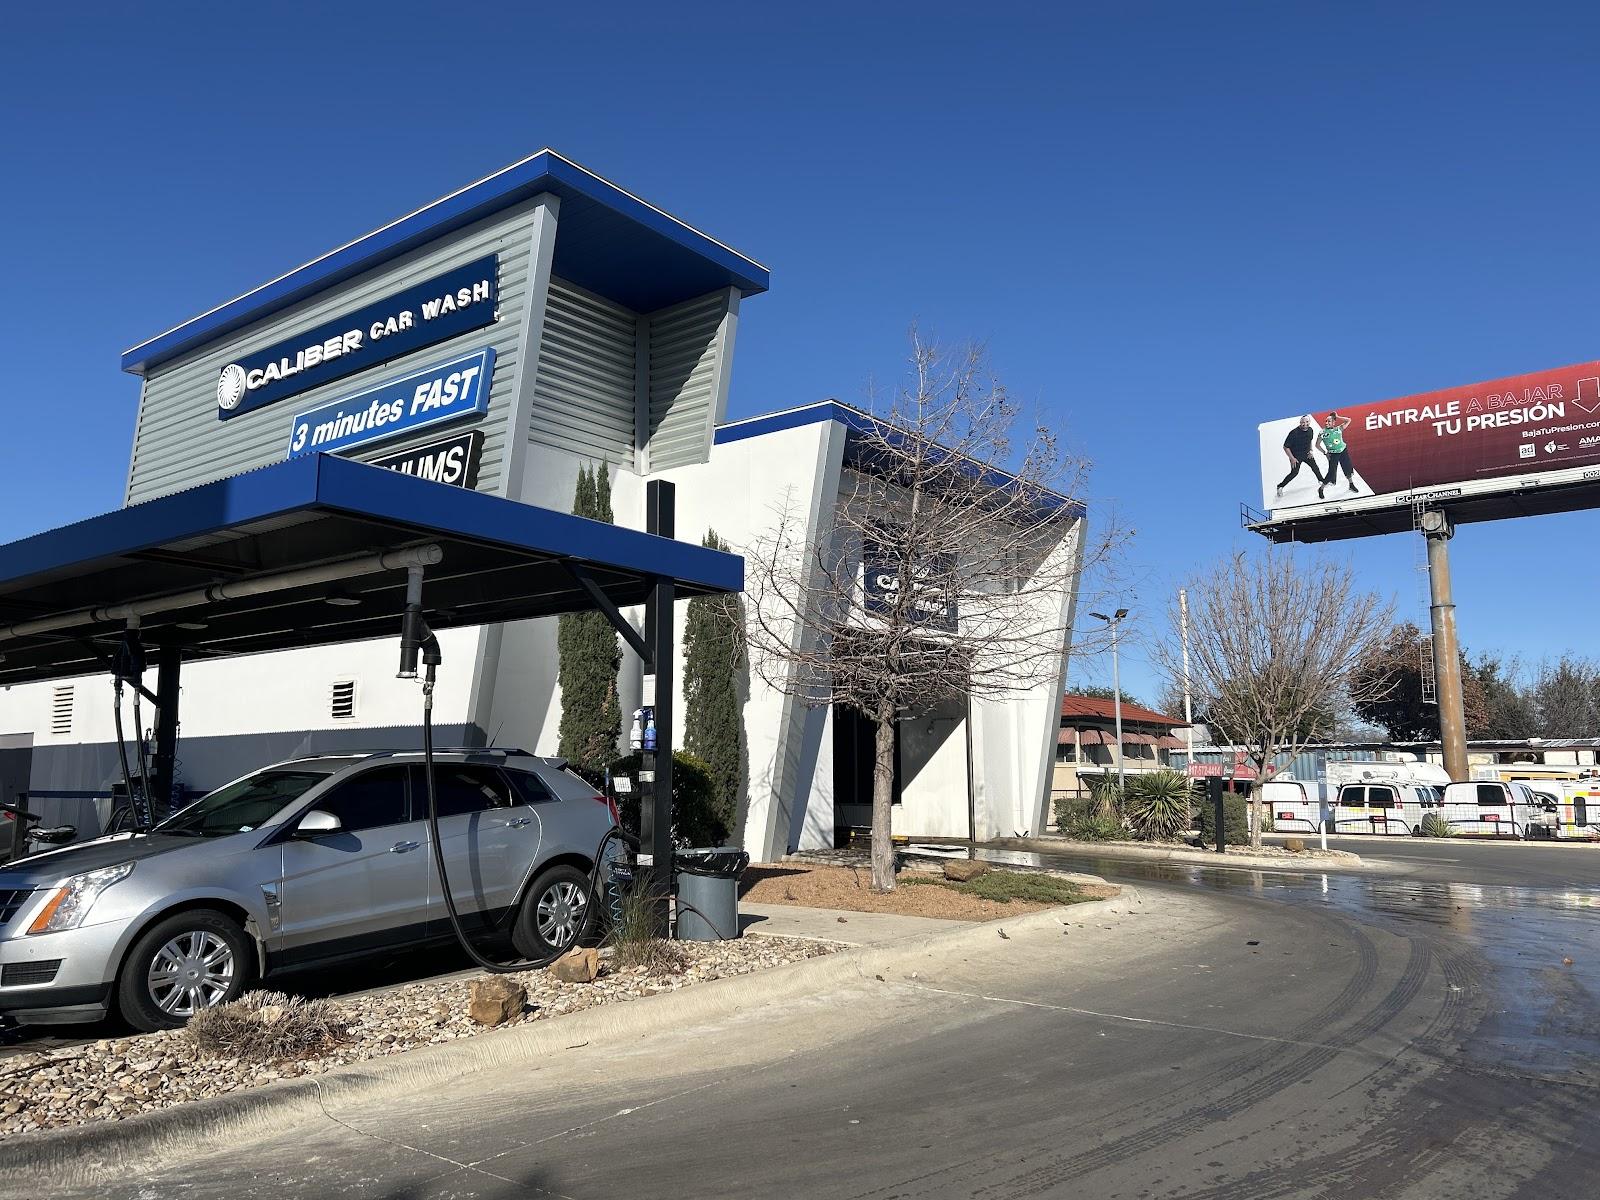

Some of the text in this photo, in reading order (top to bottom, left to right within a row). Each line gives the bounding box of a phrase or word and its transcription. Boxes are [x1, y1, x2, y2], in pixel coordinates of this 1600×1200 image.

[246, 279, 489, 390] CALIBER CAR WASH
[292, 365, 480, 452] 3 minutes FAST
[1365, 383, 1563, 431] ÉNTRALE A BAJAR
[1432, 401, 1566, 437] TU PRESIÓN
